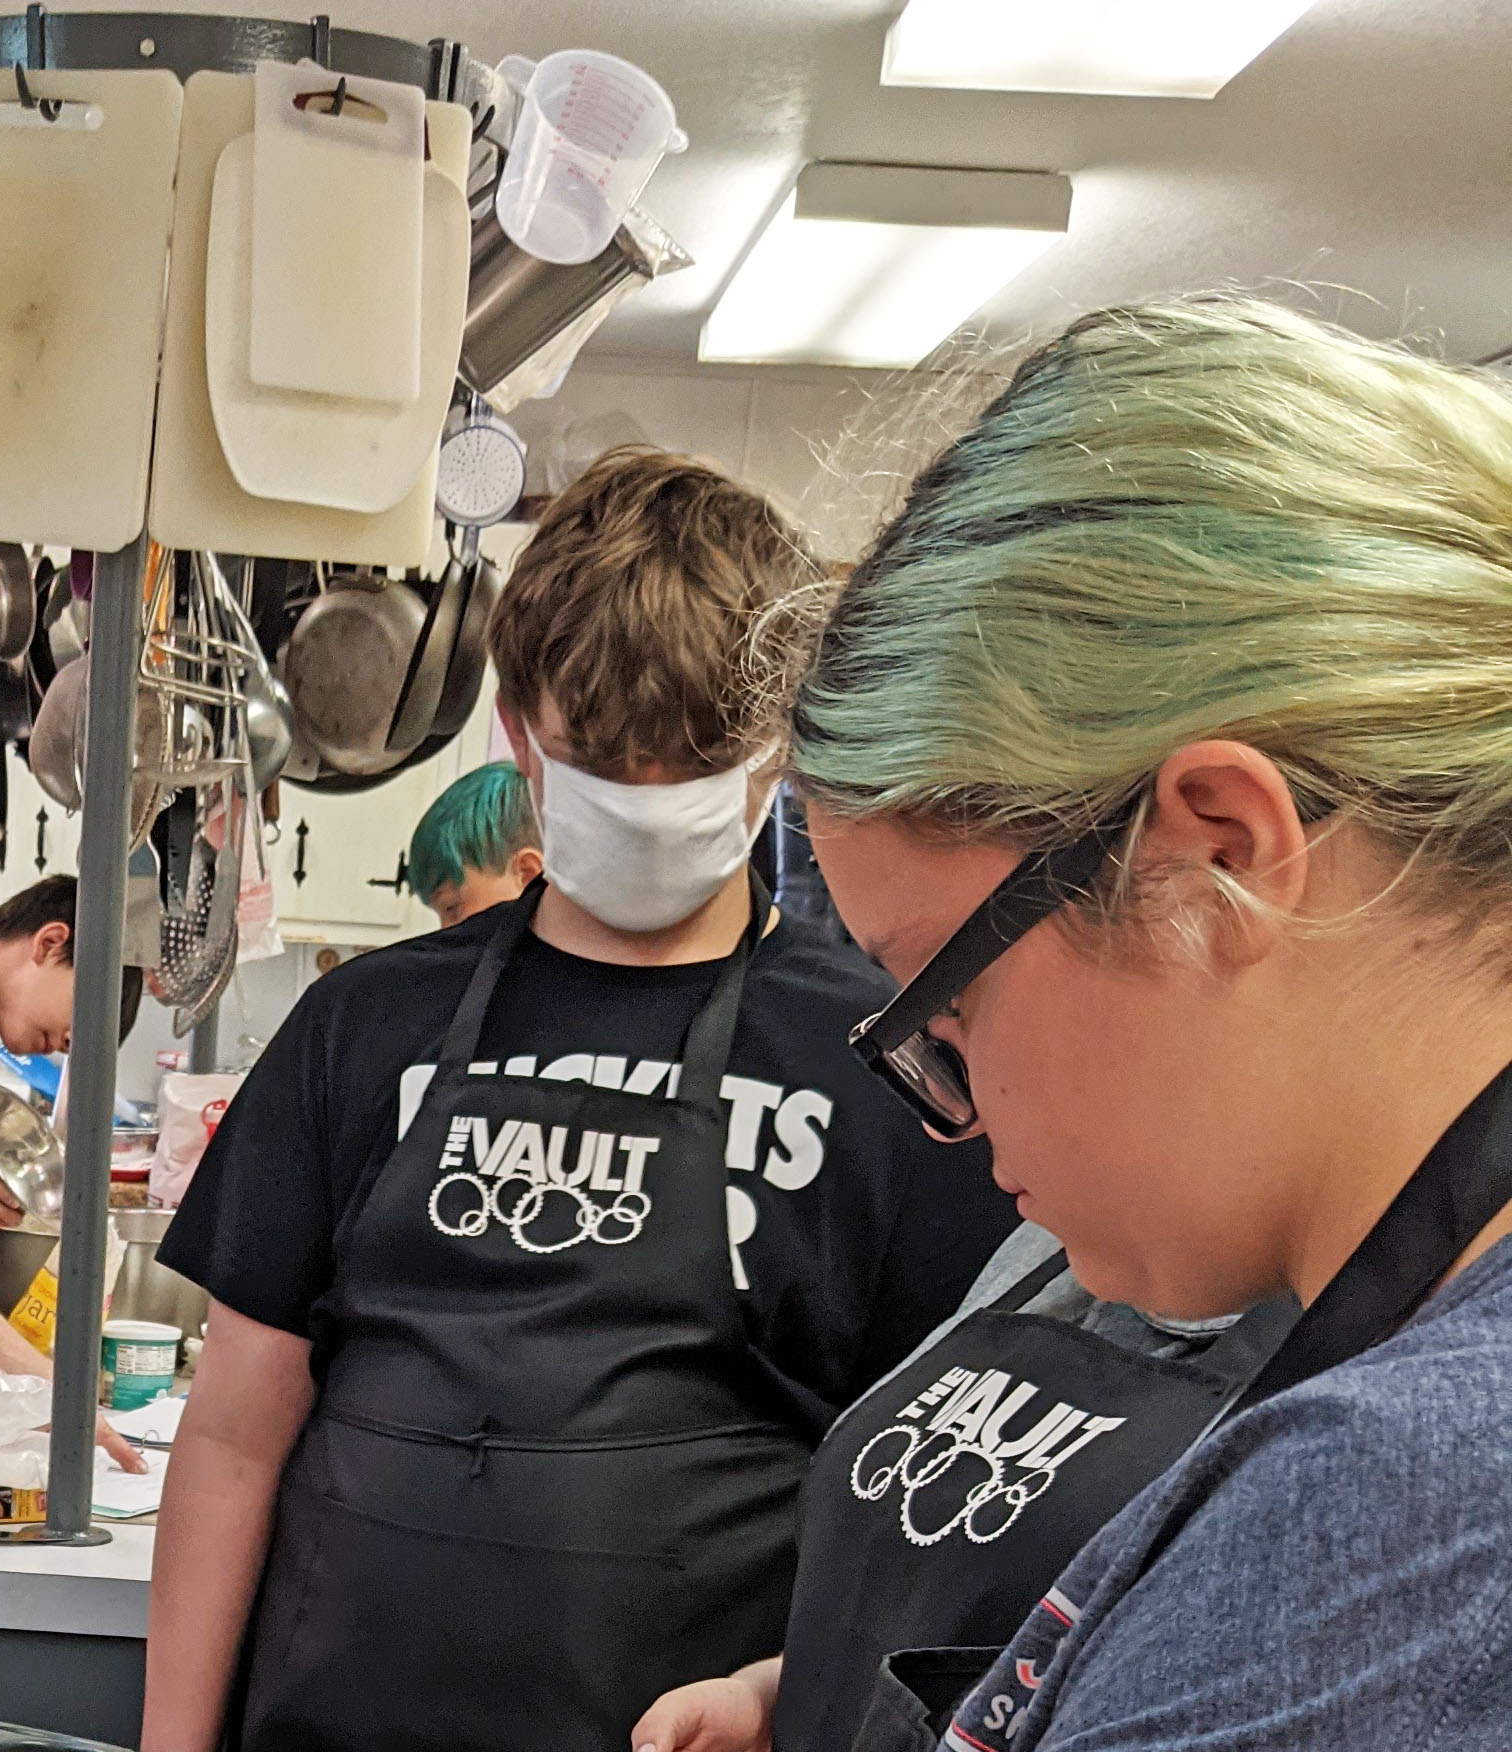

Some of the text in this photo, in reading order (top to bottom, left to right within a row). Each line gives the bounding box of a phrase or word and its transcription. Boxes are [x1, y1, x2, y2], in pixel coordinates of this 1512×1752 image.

[439, 1115, 472, 1169] THE
[469, 1116, 660, 1192] VAULT
[896, 1366, 1128, 1470] THE VAULT
